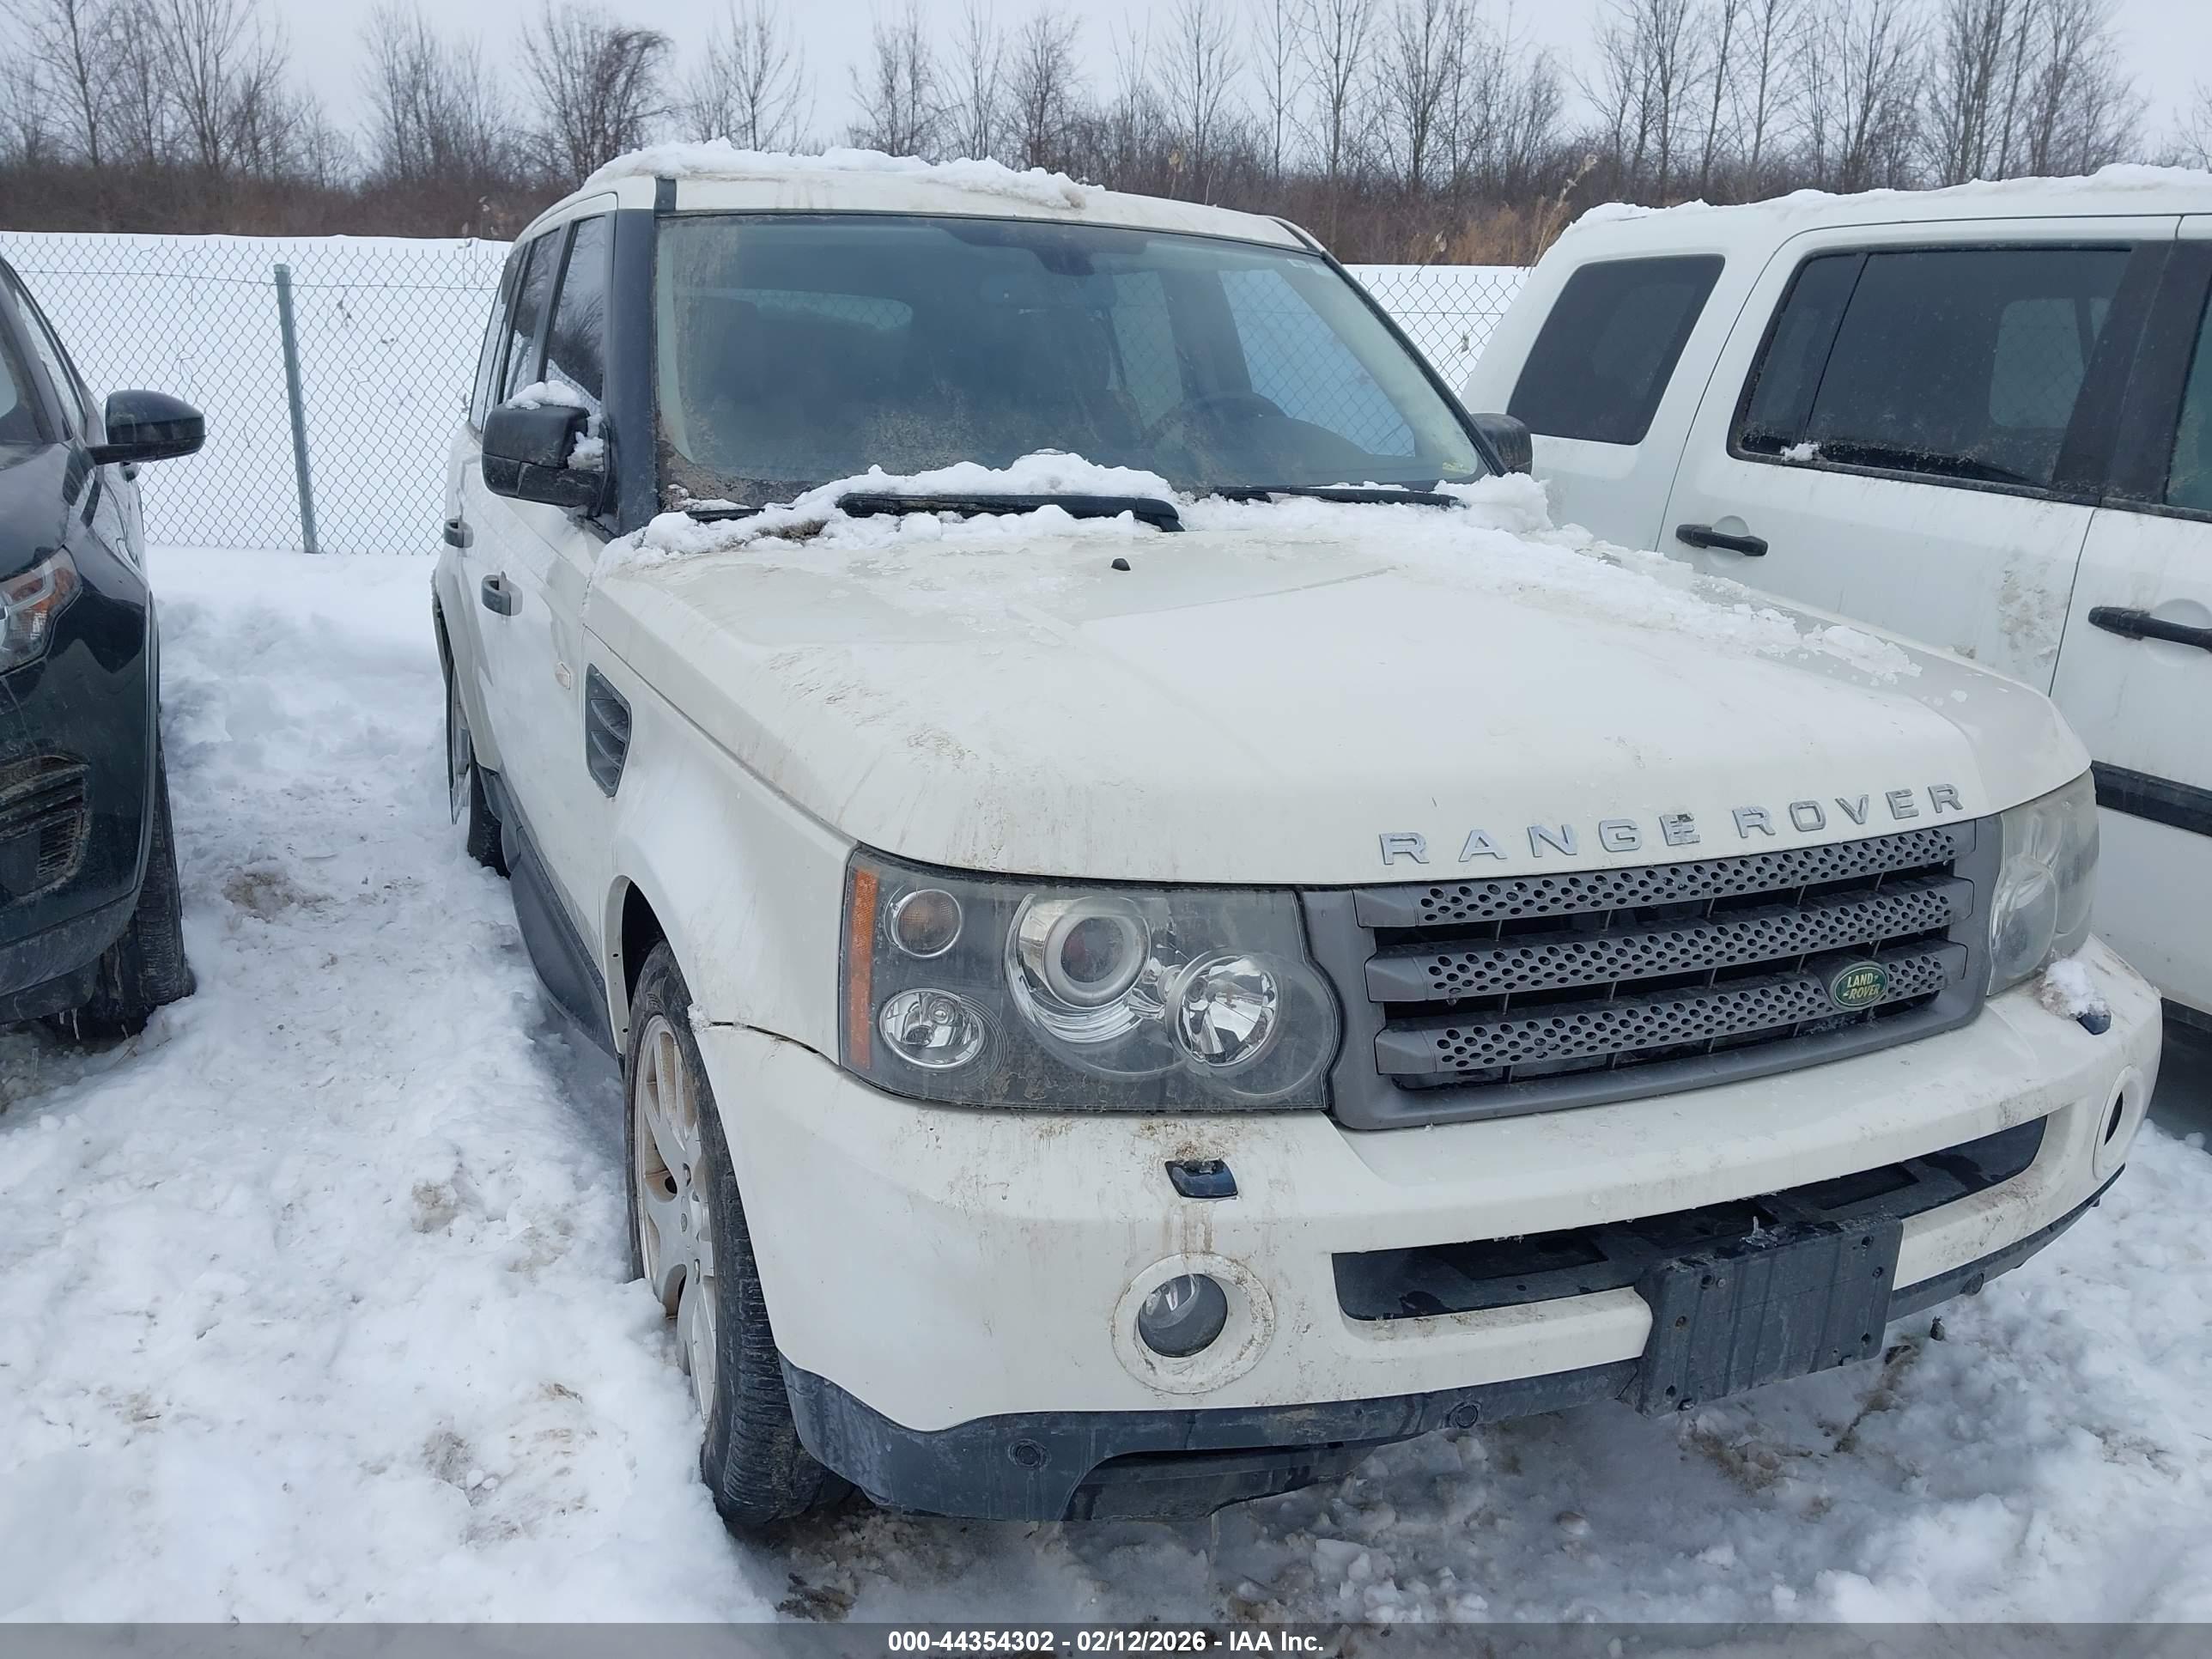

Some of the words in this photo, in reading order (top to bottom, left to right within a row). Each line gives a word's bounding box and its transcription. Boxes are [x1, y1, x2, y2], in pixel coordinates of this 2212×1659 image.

[1380, 812, 1700, 866] RANGE
[1731, 782, 1965, 838] ROVER
[1846, 972, 1874, 988] LAND
[1847, 983, 1881, 1000] ROVER
